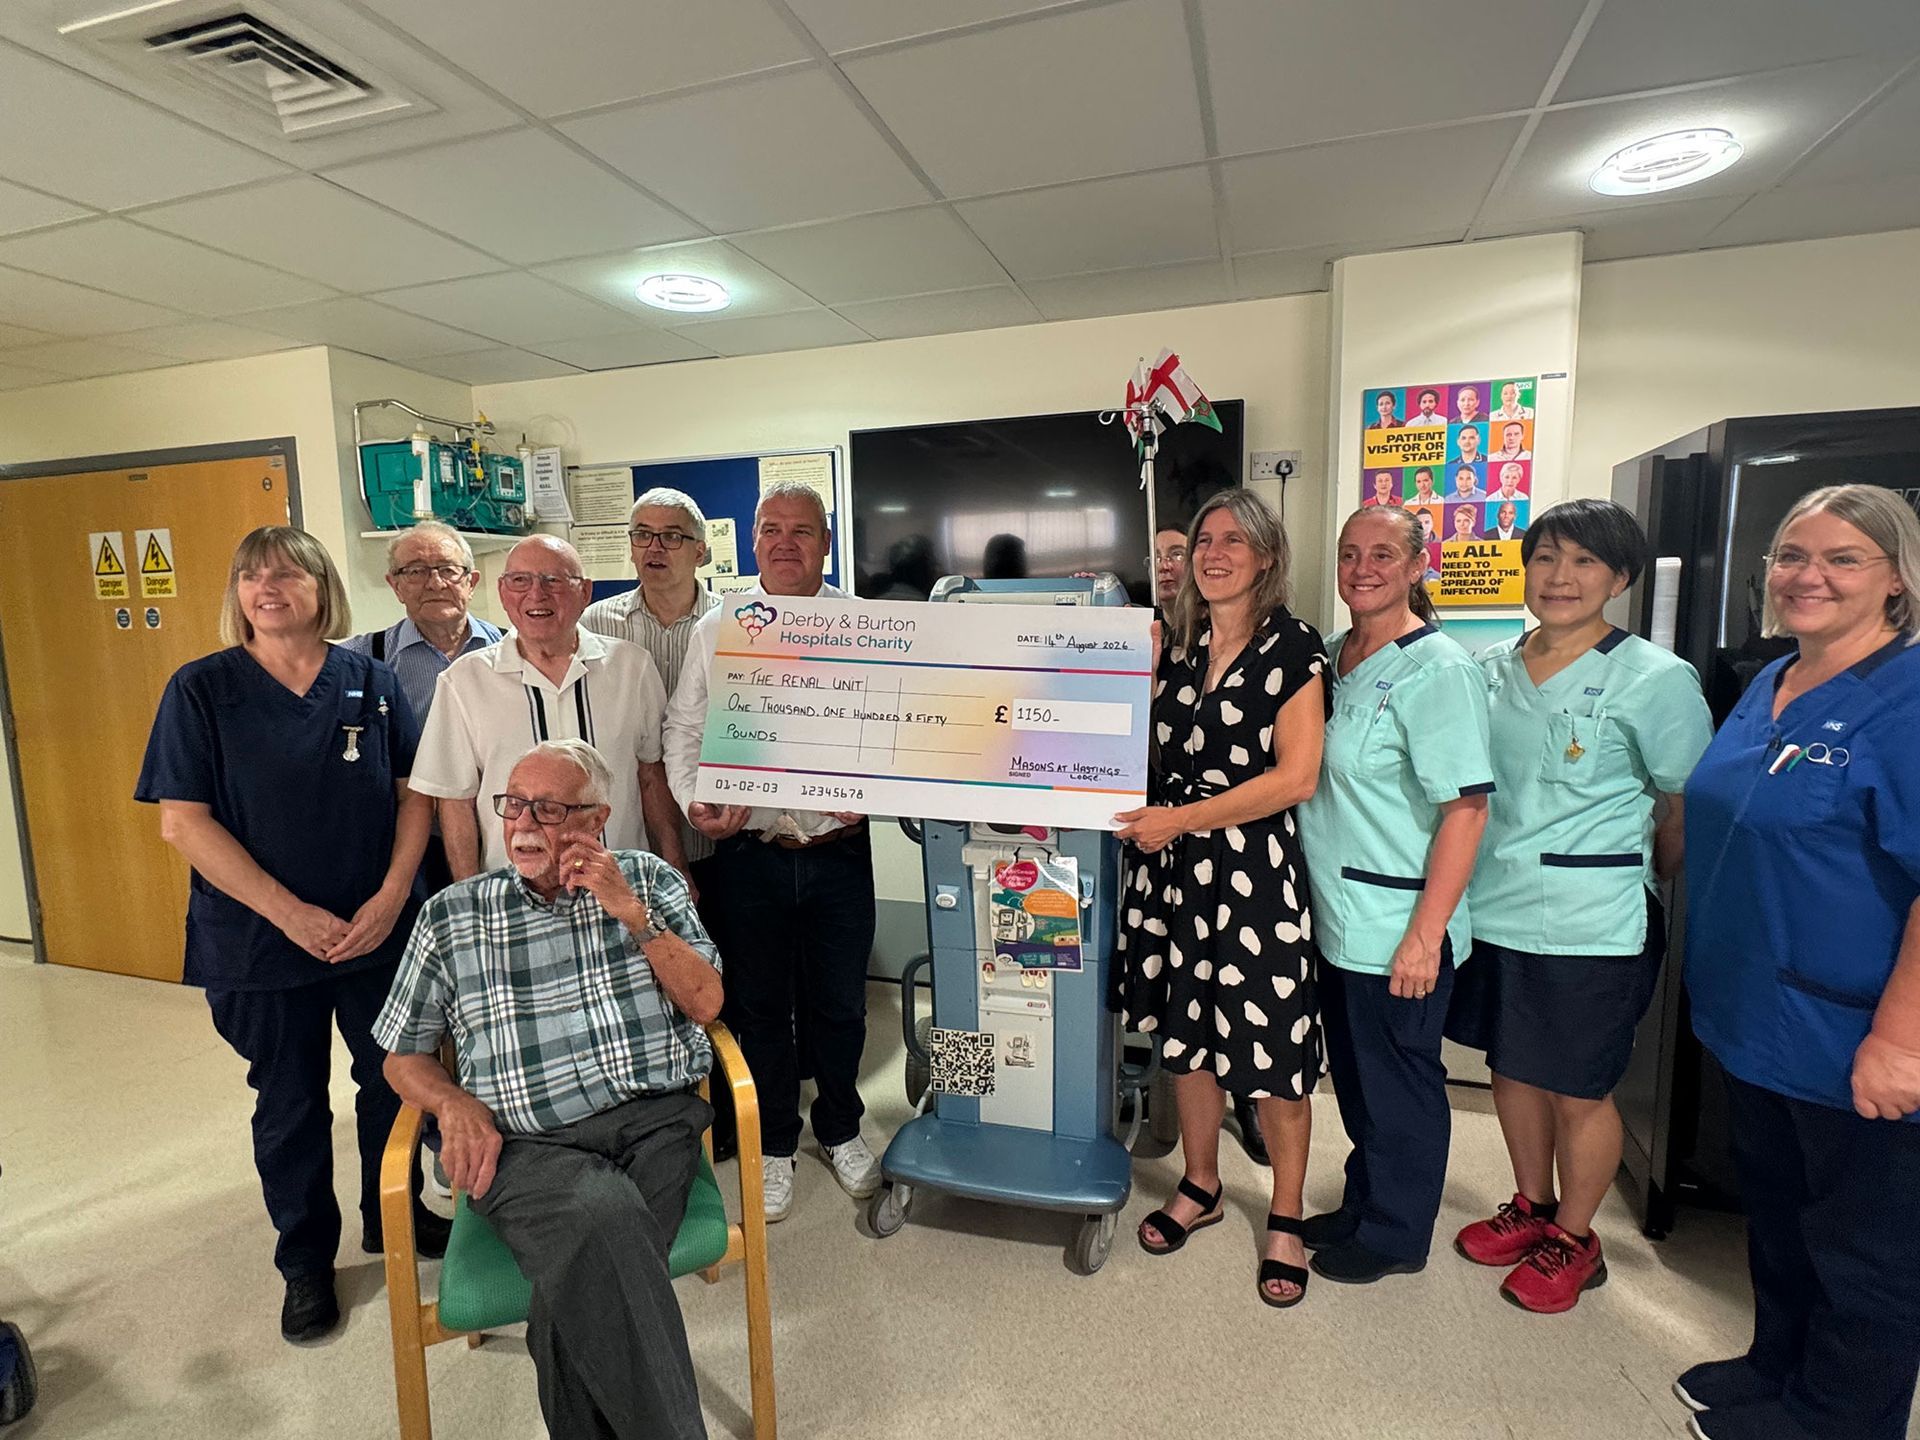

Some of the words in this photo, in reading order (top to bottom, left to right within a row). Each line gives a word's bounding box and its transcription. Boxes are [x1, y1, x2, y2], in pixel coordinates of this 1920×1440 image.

[1386, 431, 1445, 443] PATIENT
[1367, 443, 1421, 454] VISITOR
[1425, 441, 1445, 451] OR
[1401, 451, 1445, 463] STAFF
[1442, 551, 1459, 559] WE
[1463, 544, 1503, 558] ALL
[1441, 561, 1471, 569] NEED
[1475, 561, 1491, 569] TO
[1441, 569, 1494, 578] PREVENT
[1497, 569, 1520, 577] THE
[145, 577, 170, 587] Danger
[1440, 579, 1486, 587] SPREAD
[1489, 578, 1504, 586] OF
[1440, 587, 1499, 596] INFECTION
[782, 611, 836, 632] Derby
[838, 614, 852, 629] &
[857, 615, 917, 632] Burton
[780, 631, 853, 648] Hospitals
[856, 634, 914, 653] Charity
[1102, 641, 1129, 650] 2026
[750, 667, 775, 686] THE
[781, 673, 827, 690] RENAL
[832, 677, 865, 692] UNIT
[823, 706, 847, 719] ONE
[916, 713, 948, 726] FIFTY
[994, 704, 1009, 724] £
[727, 723, 778, 742] POUNDS
[1010, 755, 1055, 773] MASONS
[1056, 764, 1068, 773] AT
[1073, 762, 1121, 777] HASTINGS
[1008, 771, 1032, 779] SIGNED
[715, 778, 779, 793] 01-02-03
[800, 784, 864, 799] 12345678
